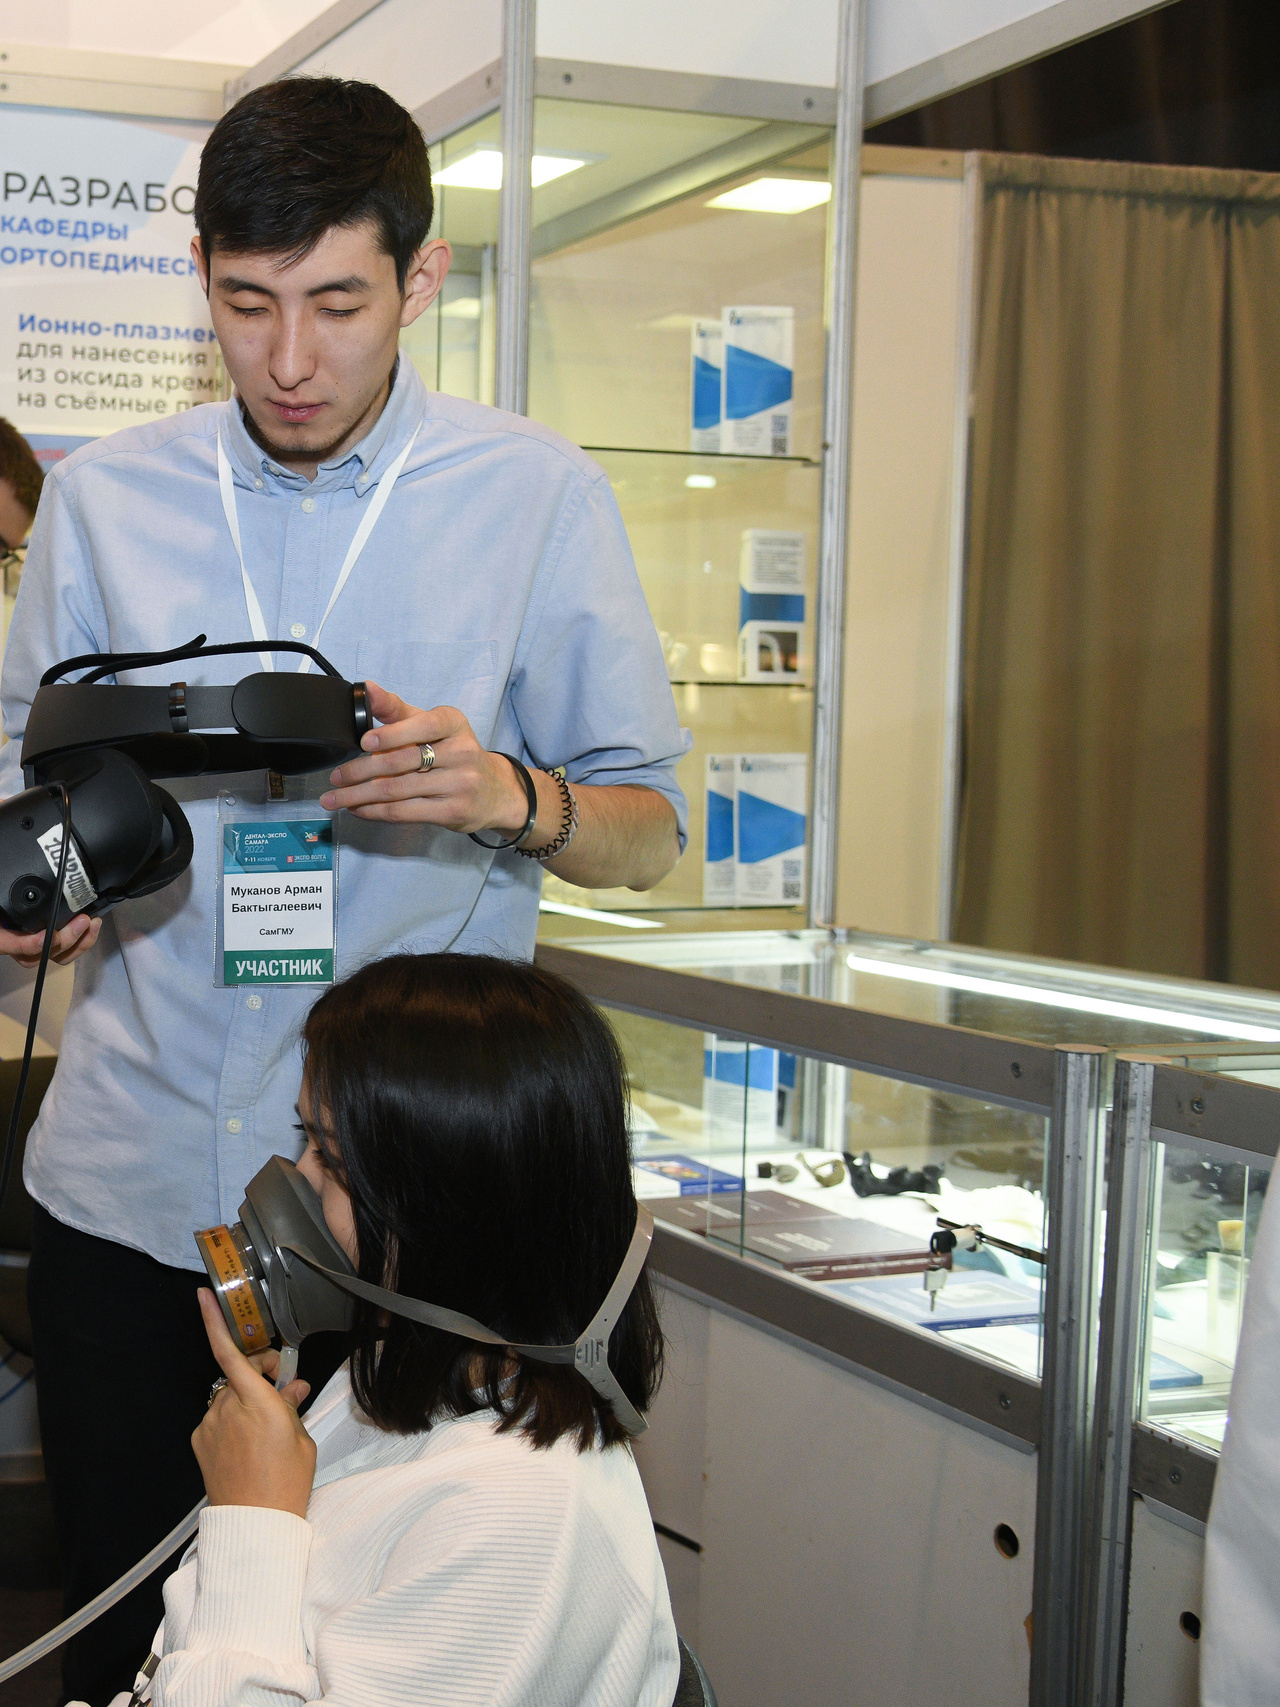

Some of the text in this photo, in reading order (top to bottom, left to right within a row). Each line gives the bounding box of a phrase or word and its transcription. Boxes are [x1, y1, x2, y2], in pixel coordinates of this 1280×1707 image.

[3, 172, 197, 215] РАЗРАБО
[0, 215, 129, 241] КАФЕДРЫ
[16, 342, 63, 360] для
[71, 345, 208, 367] нанесения
[17, 367, 46, 383] из
[54, 368, 144, 389] оксида
[18, 392, 47, 408] на
[55, 391, 169, 414] съёмные
[244, 832, 288, 840] ДЕНТАЛ-ЭКСПО
[244, 845, 265, 854] 2022
[231, 884, 323, 899] Муканов Арман
[231, 902, 322, 913] Бактыгалеевич
[259, 927, 295, 937] СамГМУ
[235, 959, 324, 977] УЧАСТНИК
